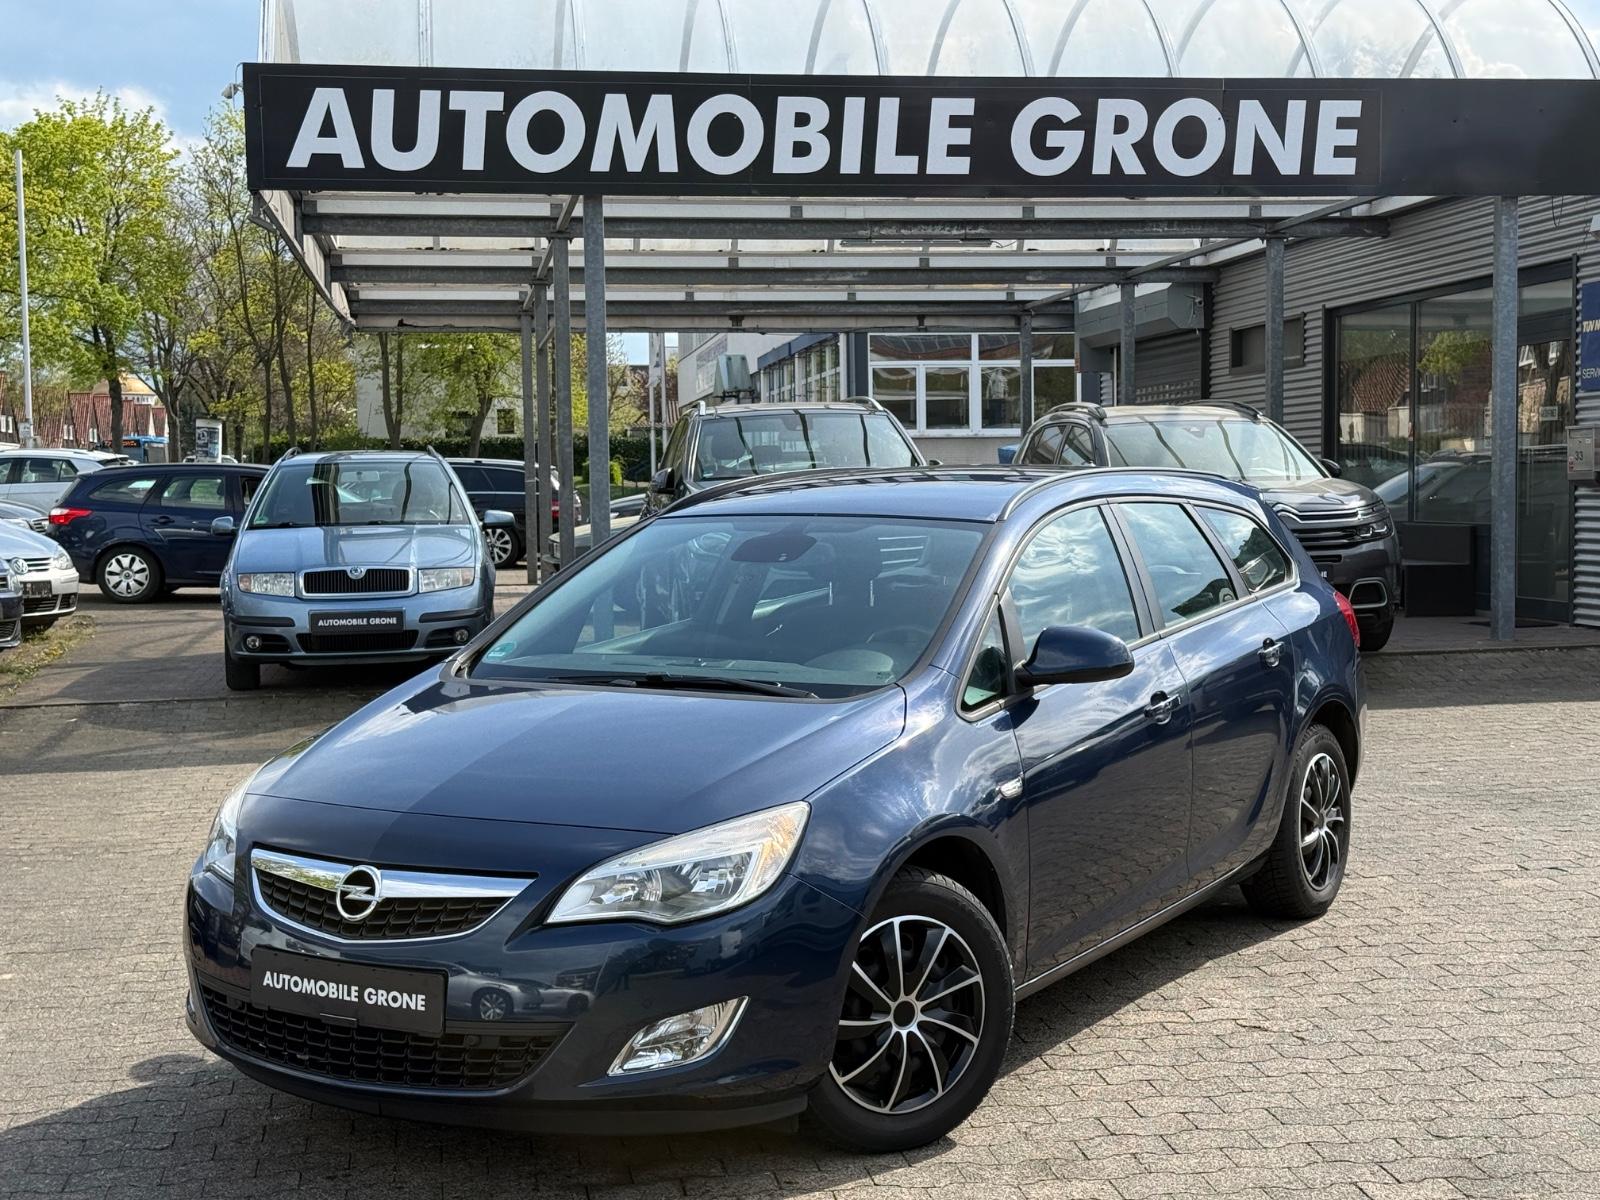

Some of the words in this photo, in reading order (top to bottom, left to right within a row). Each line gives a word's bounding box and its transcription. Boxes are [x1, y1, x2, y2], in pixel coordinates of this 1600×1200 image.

[286, 87, 974, 176] AUTOMOBILE
[1010, 96, 1363, 178] GRONE
[318, 618, 368, 626] AUTOMOBILE
[369, 617, 397, 625] GRONE
[262, 970, 359, 1002] AUTOMOBILE
[363, 987, 426, 1011] GRONE
